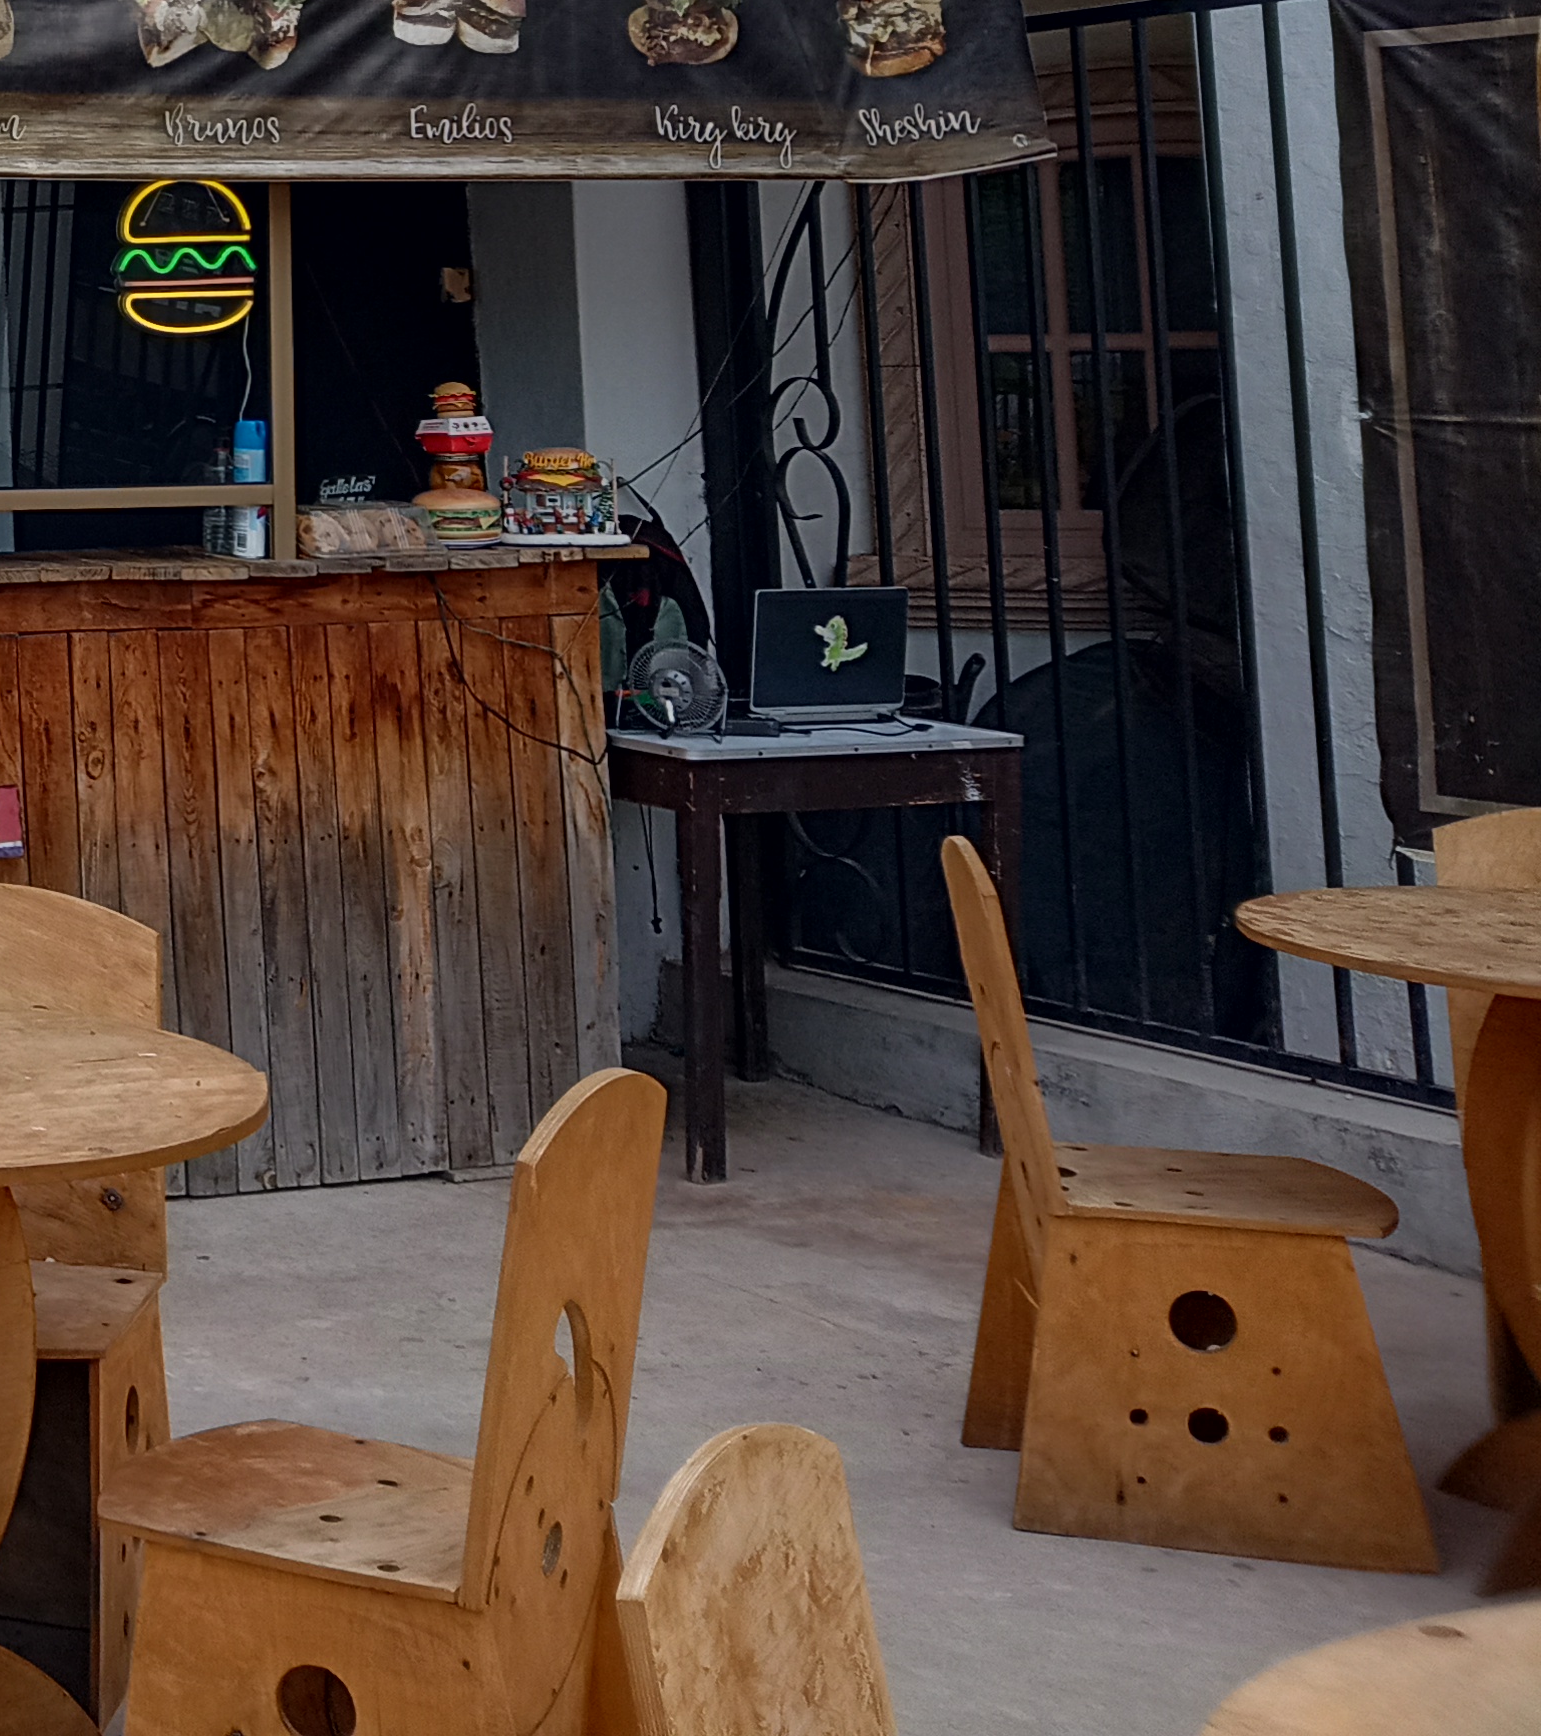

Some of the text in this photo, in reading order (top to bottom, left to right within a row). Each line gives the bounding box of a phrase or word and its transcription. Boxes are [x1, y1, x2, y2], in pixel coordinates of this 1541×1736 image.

[164, 102, 281, 146] Brunos
[409, 102, 514, 144] Emilios
[858, 102, 982, 146] Sheshin
